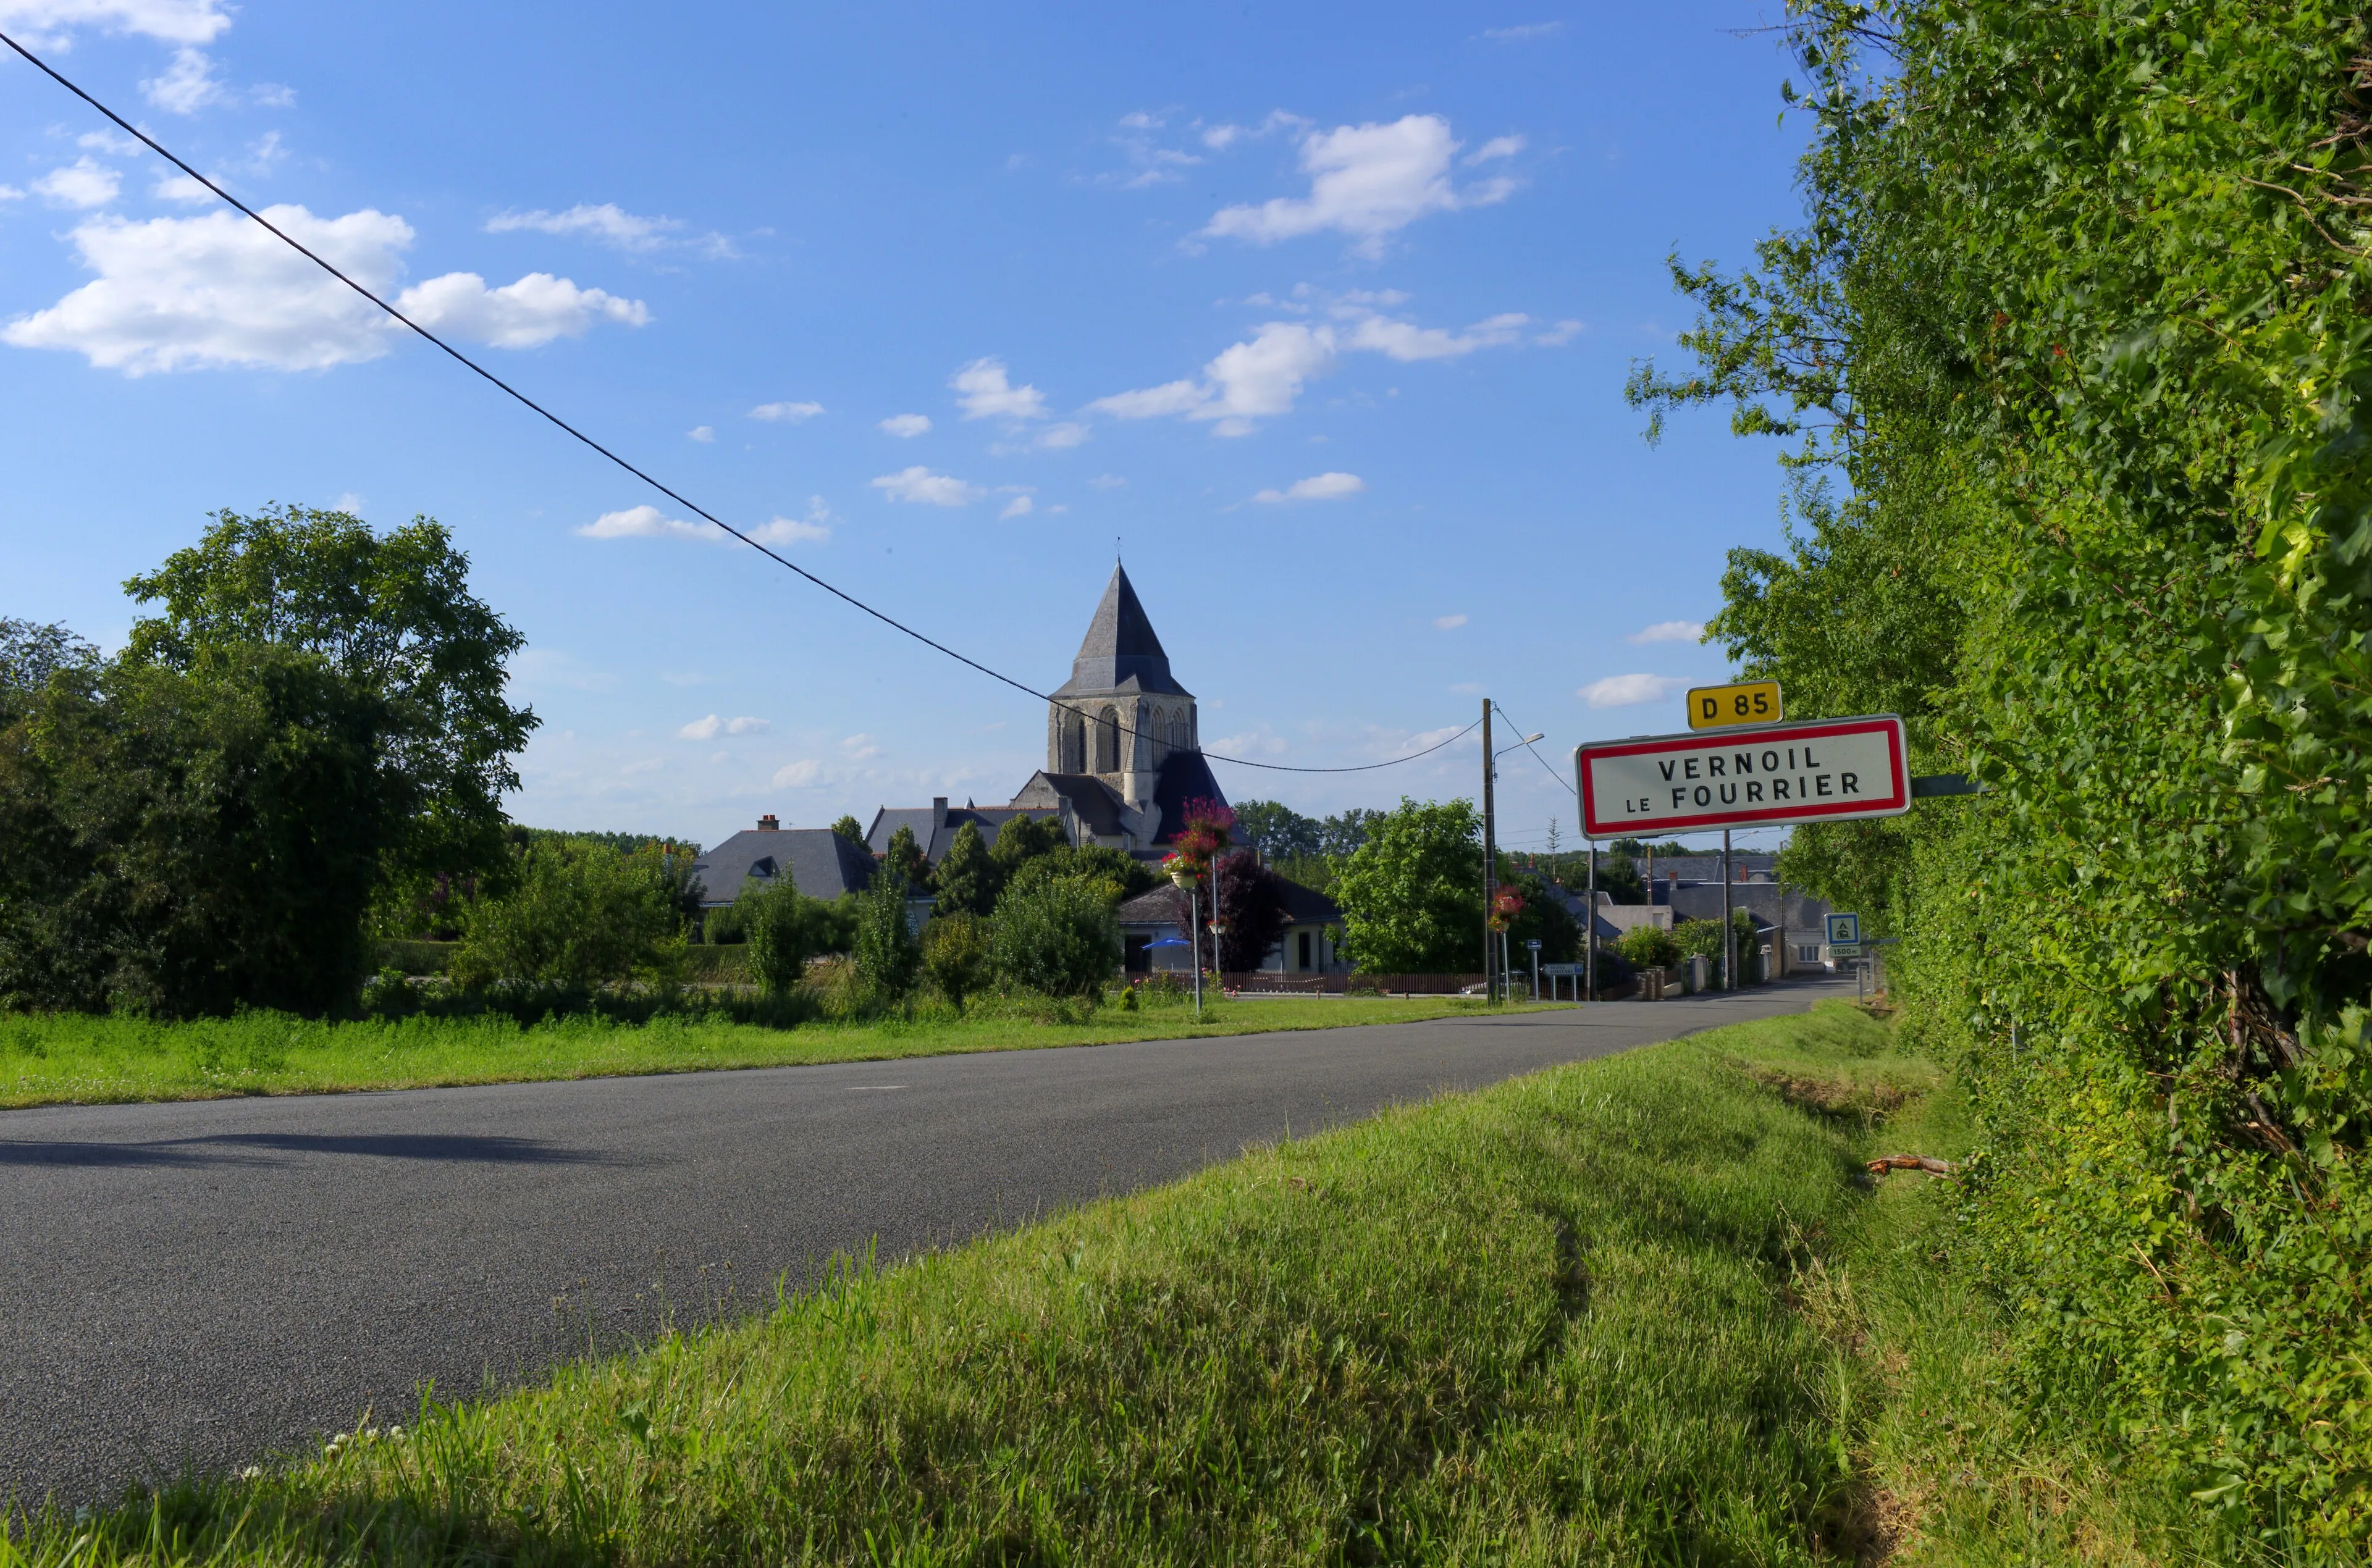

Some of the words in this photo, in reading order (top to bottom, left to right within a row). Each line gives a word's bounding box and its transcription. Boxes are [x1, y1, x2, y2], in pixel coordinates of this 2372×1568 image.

[1702, 698, 1718, 719] D
[1734, 692, 1768, 716] 85
[1658, 747, 1820, 781] VERNOIL
[1626, 798, 1651, 813] LE
[1672, 772, 1860, 809] FOURRIER
